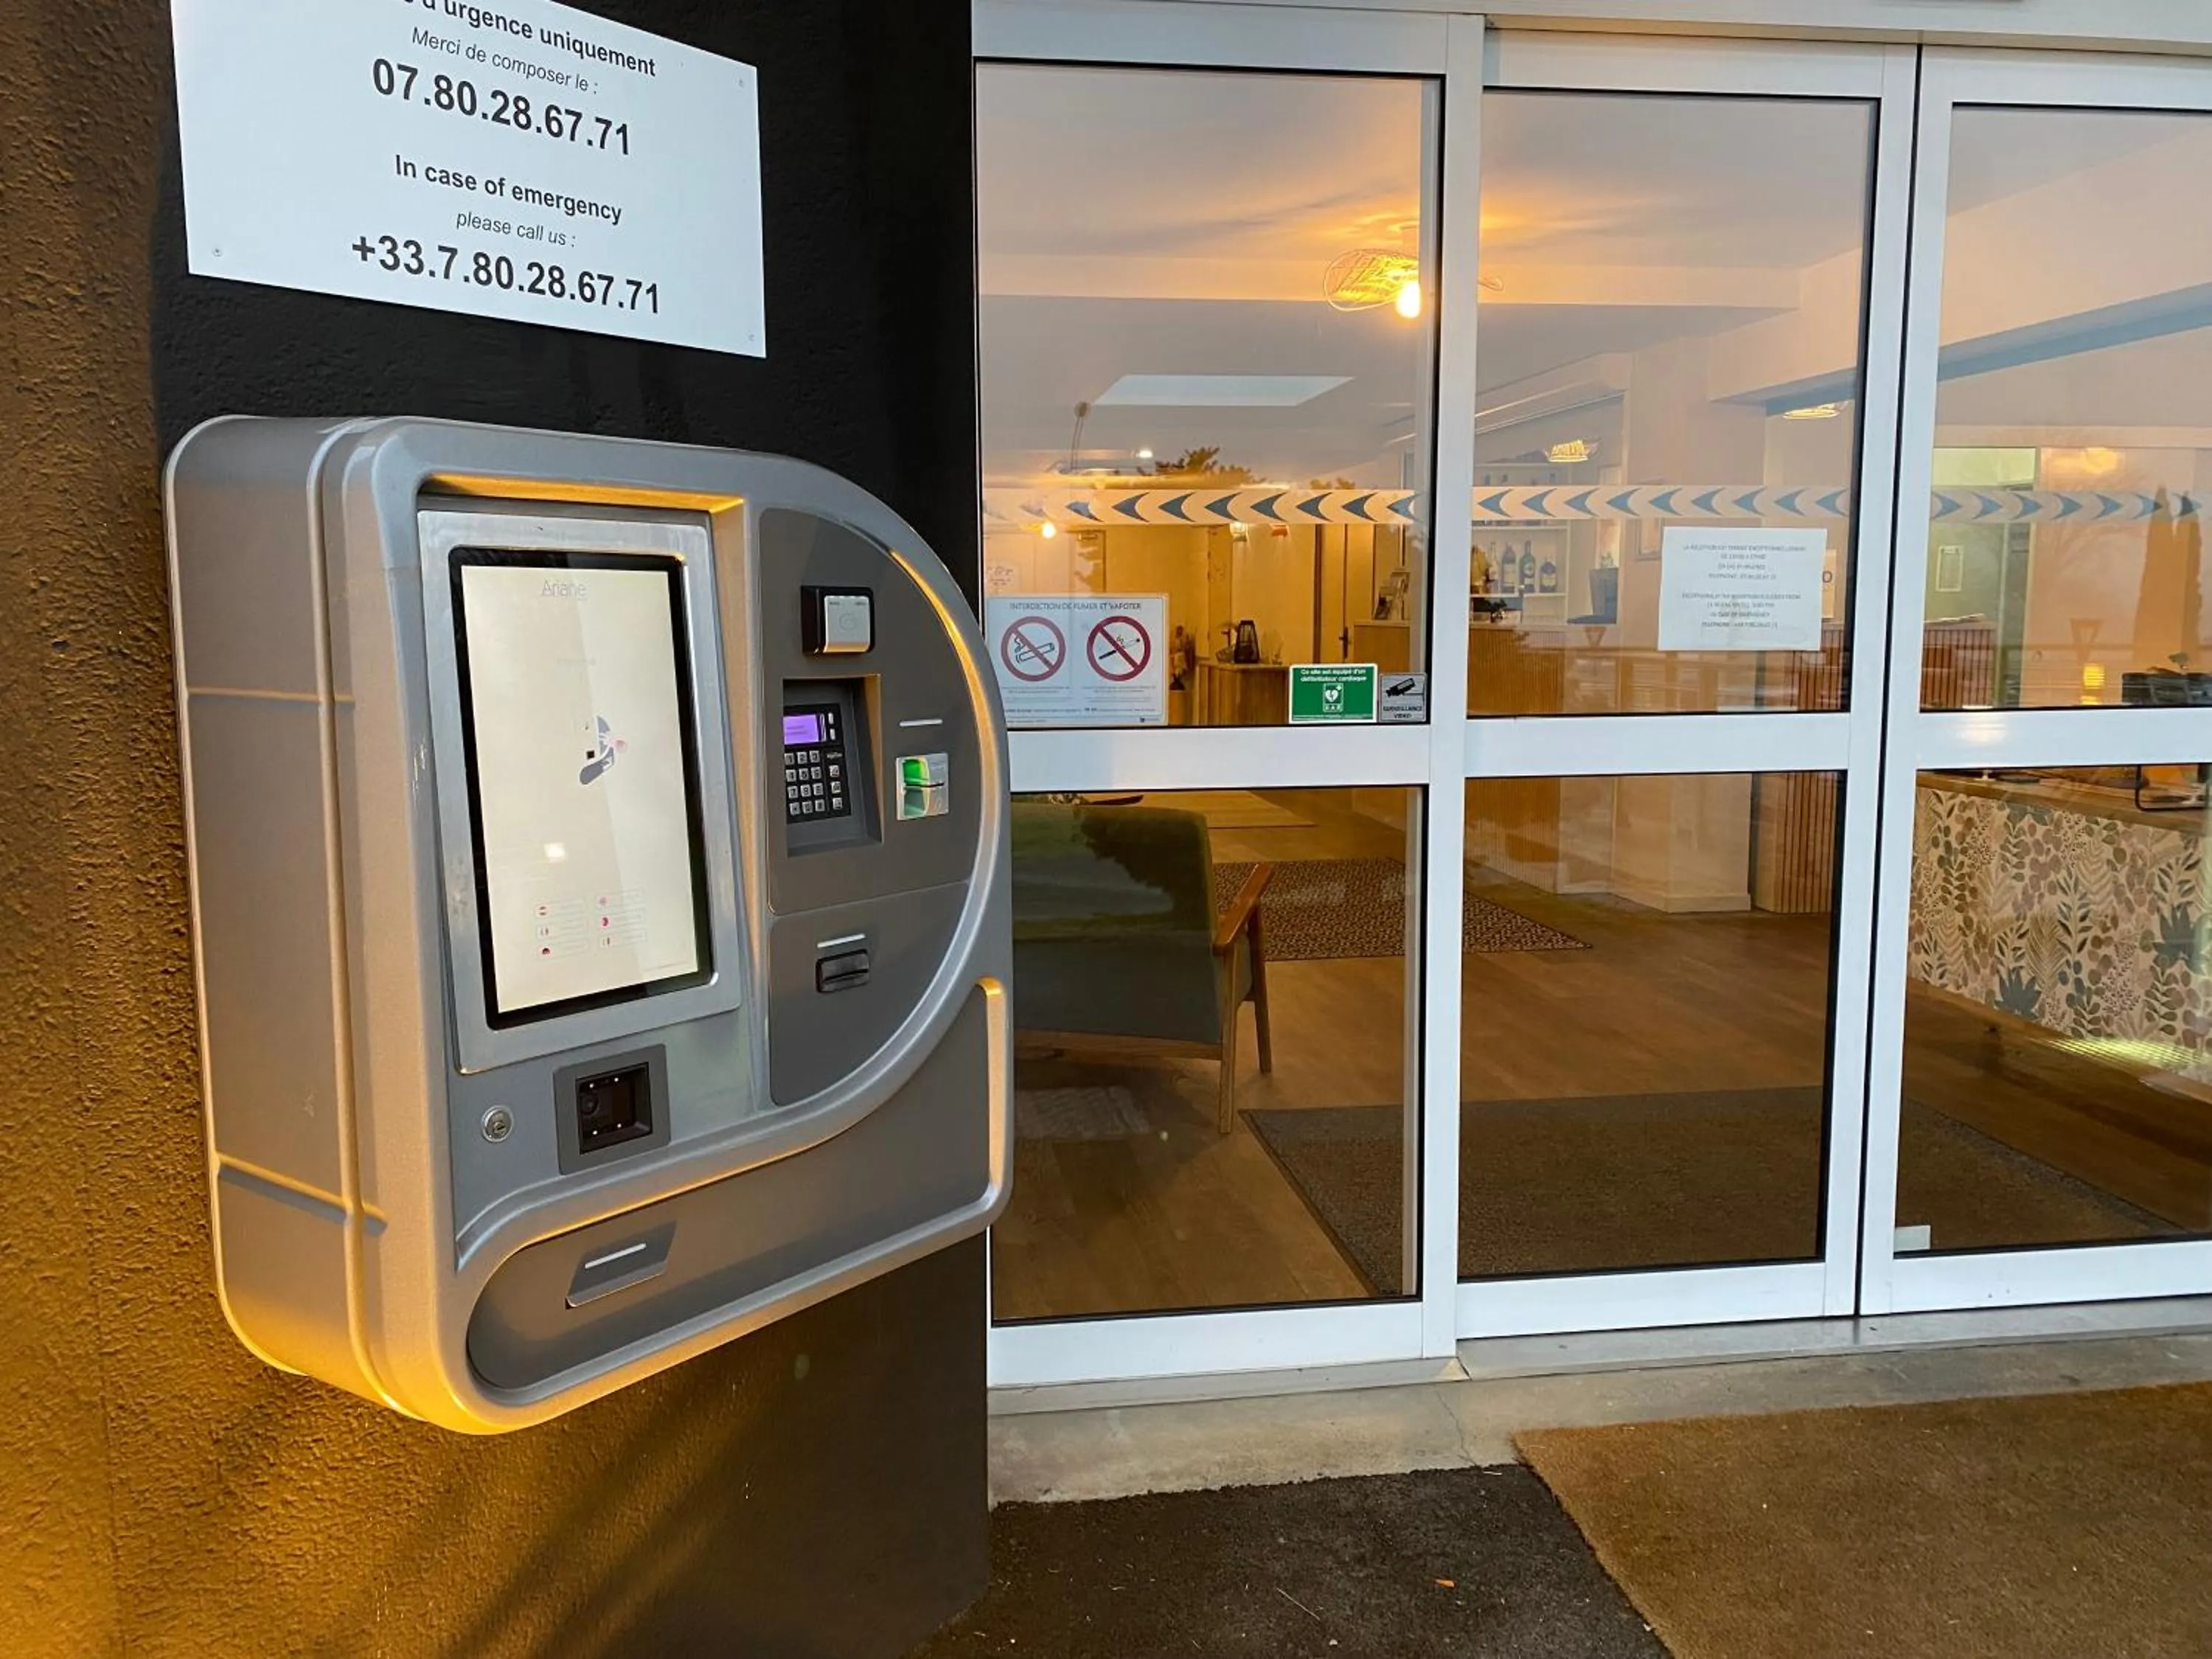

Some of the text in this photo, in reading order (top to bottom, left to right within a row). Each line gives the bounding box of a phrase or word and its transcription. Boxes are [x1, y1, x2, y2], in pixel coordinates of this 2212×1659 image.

[412, 27, 461, 55] Merci
[465, 44, 487, 63] de
[492, 53, 573, 86] composer
[574, 74, 588, 91] le
[422, 0, 655, 77] urgence uniquement
[373, 58, 629, 155] 07.80.28.67.71
[395, 155, 622, 225] In case of emergency
[456, 212, 511, 234] please
[517, 224, 543, 241] call
[549, 232, 566, 246] us
[352, 235, 658, 314] +33.7.80.28.67.71
[542, 580, 587, 597] Ariane
